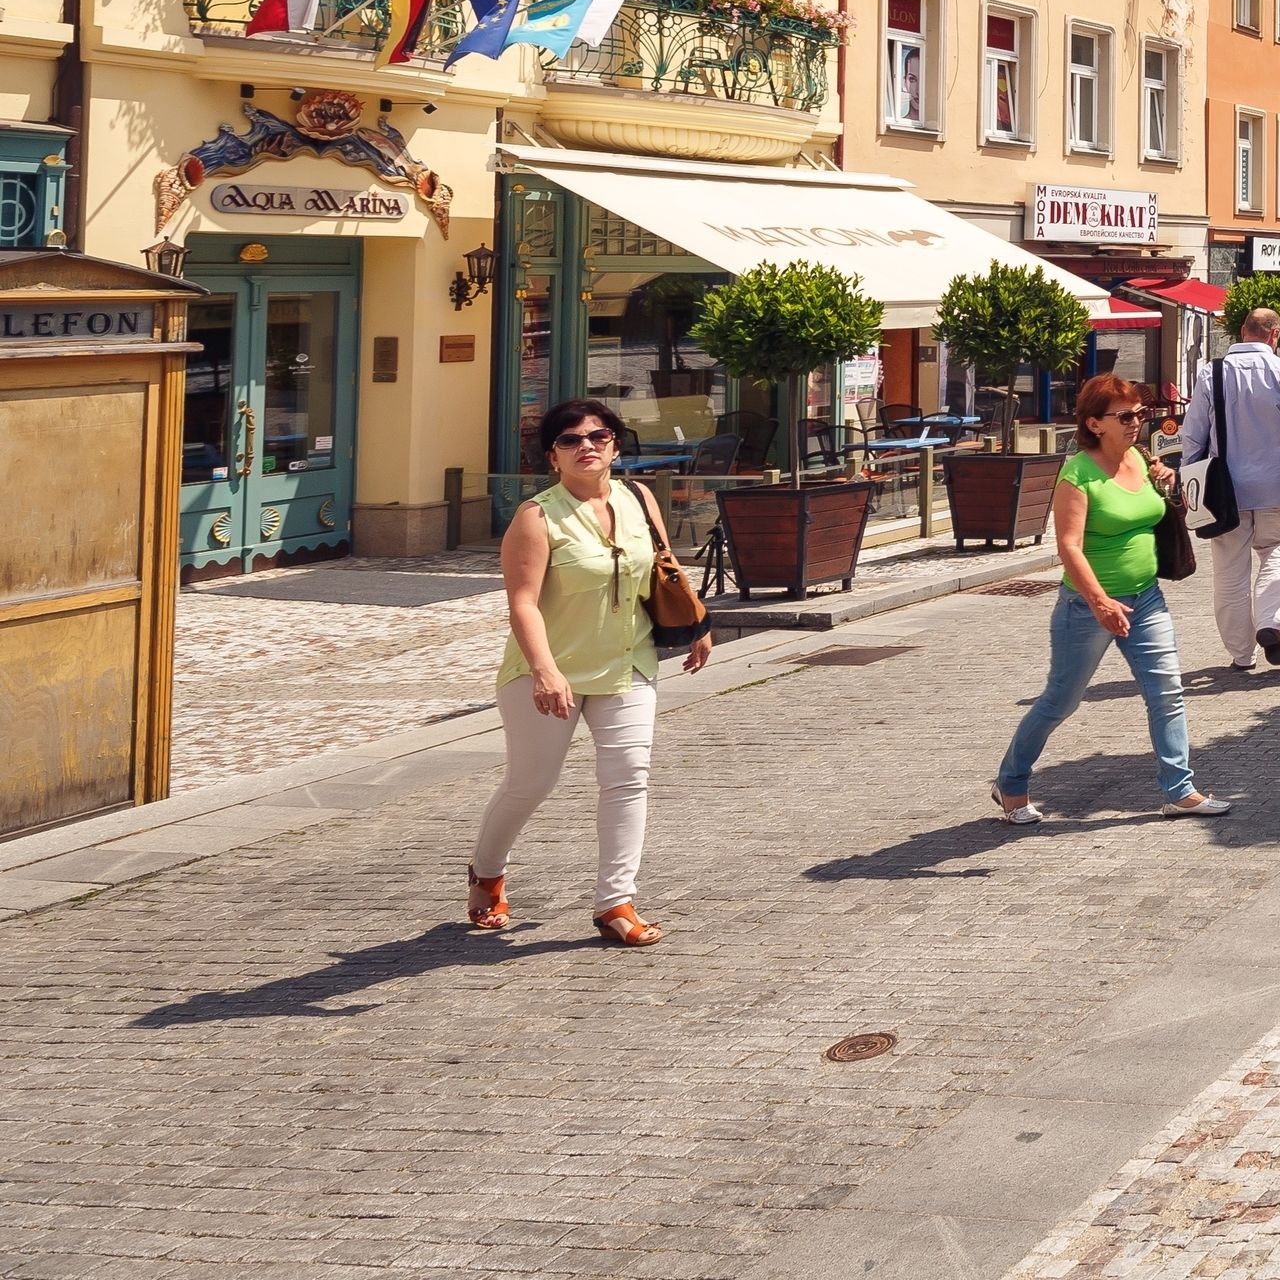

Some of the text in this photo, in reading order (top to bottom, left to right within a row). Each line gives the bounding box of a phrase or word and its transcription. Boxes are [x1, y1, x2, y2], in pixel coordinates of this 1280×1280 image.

[1051, 189, 1106, 200] EVROPSKÁ KVALITA
[702, 221, 901, 248] MATTONI
[1261, 244, 1277, 256] ROY
